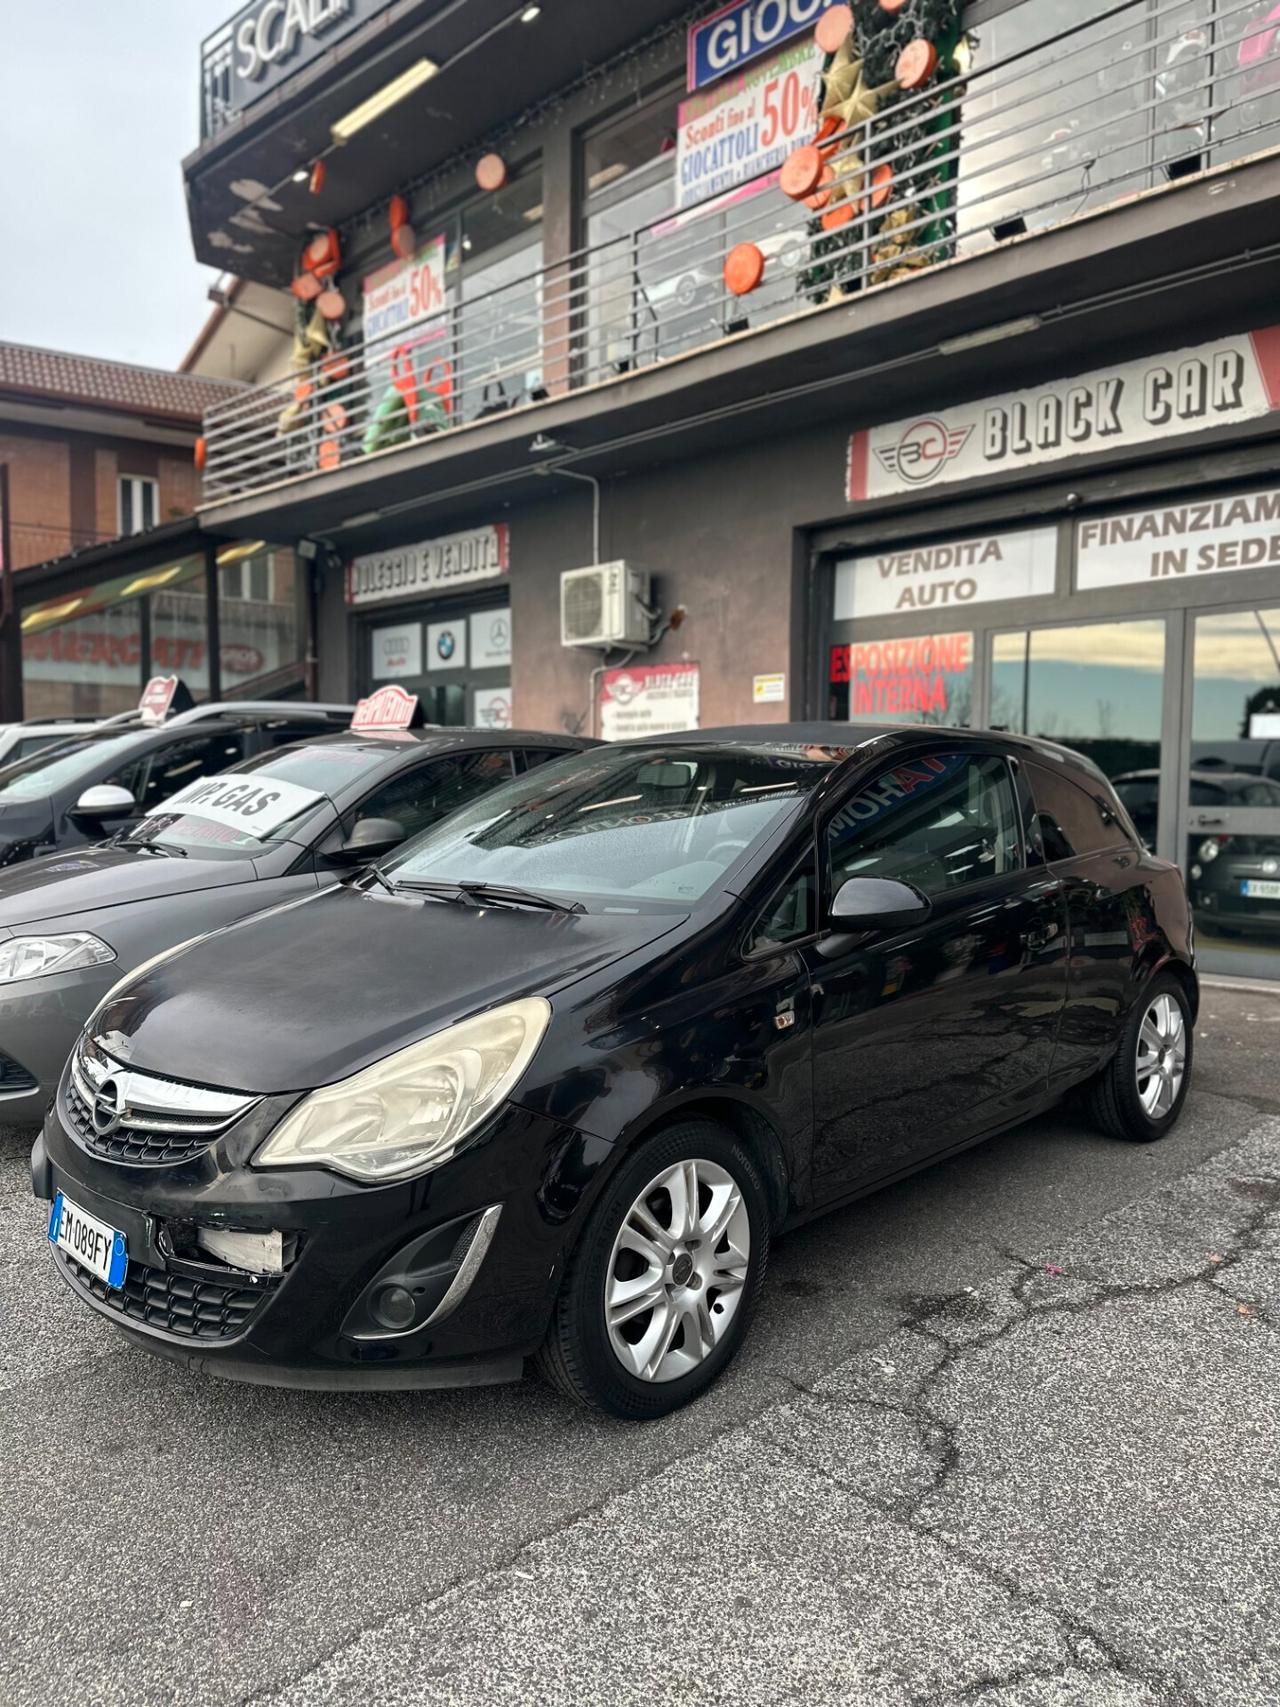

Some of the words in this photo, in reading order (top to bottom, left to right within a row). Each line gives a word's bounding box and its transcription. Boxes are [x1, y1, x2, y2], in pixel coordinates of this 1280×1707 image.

[685, 104, 725, 149] Sconti
[761, 71, 822, 147] 50%
[682, 121, 759, 186] GIOCATTOLI
[409, 263, 443, 317] 50%
[984, 377, 1125, 460] BLACK
[1143, 350, 1245, 426] CAR
[434, 534, 499, 580] VENDITA
[877, 540, 1003, 580] VENDITA
[1150, 547, 1189, 578] IN
[1197, 534, 1280, 571] SEDE
[896, 578, 978, 610] AUTO
[830, 636, 969, 682] ESPOSIZIONE
[853, 675, 947, 716] INTERNA
[211, 784, 281, 816] GAS
[74, 1218, 113, 1271] 089FY
